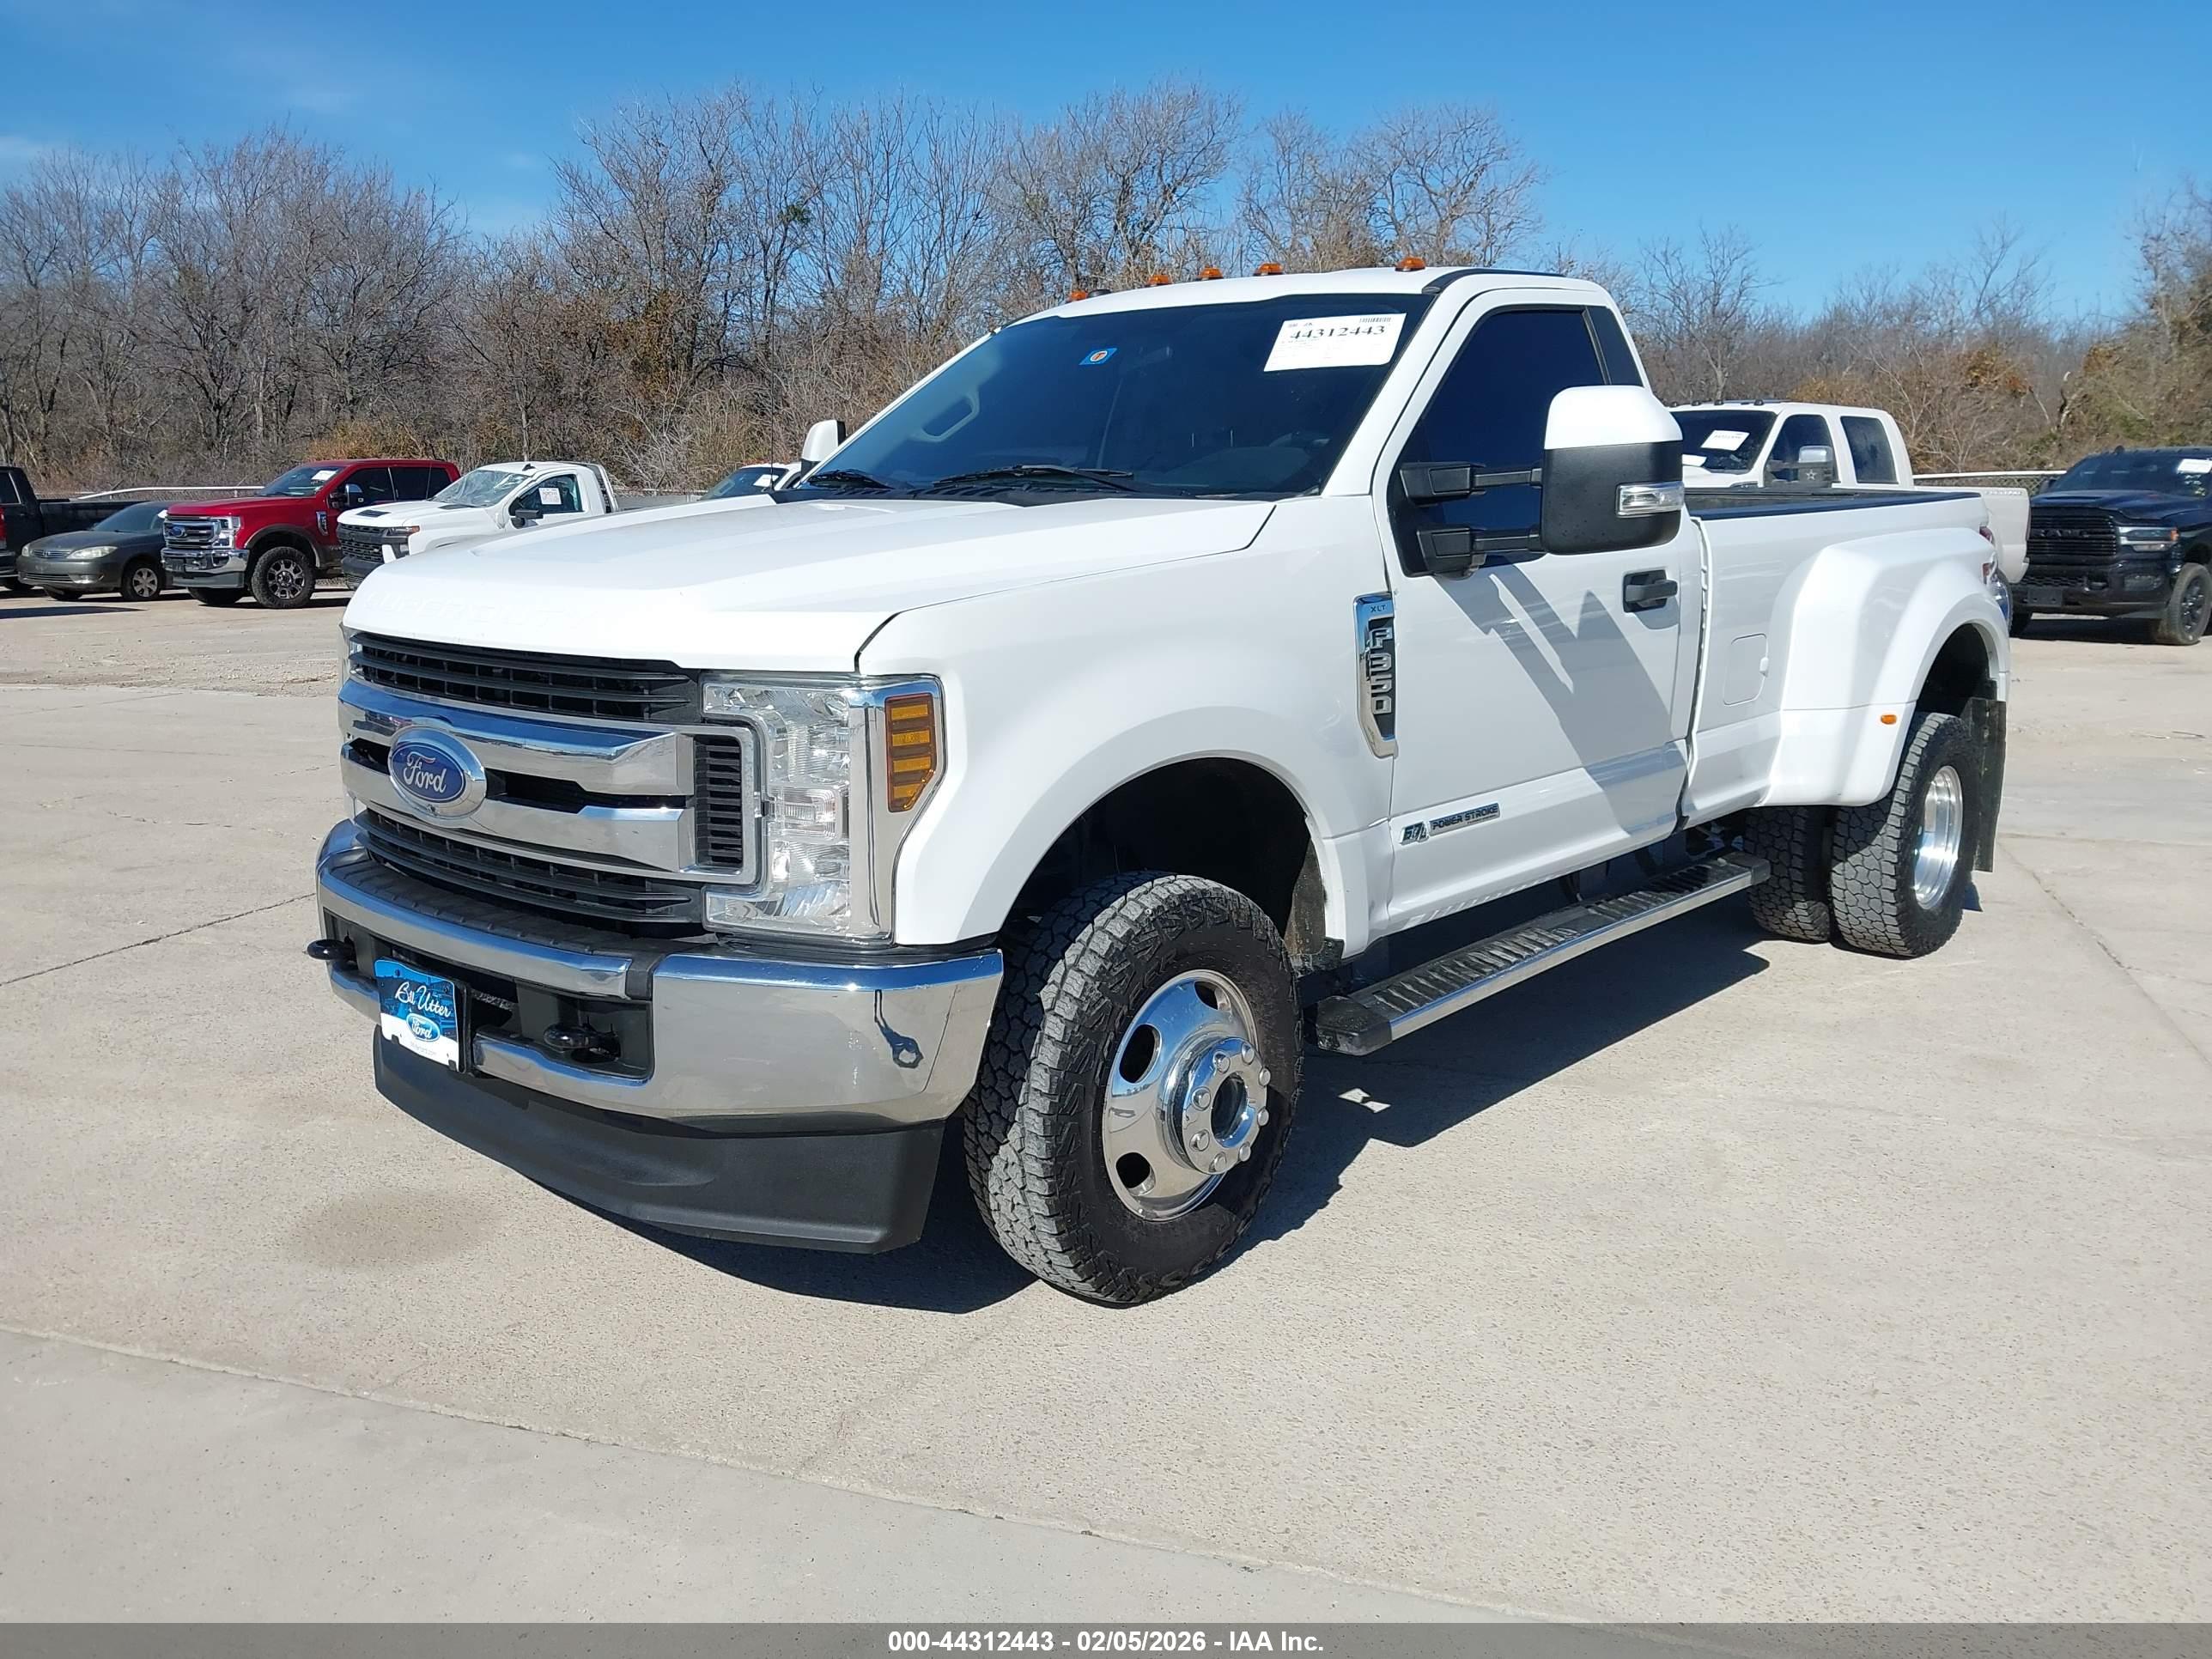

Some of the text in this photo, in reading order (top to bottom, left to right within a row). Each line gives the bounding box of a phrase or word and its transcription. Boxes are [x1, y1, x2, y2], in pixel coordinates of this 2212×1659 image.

[1290, 325, 1385, 339] 44312443
[1370, 605, 1386, 613] XLT
[404, 751, 447, 793] Ford
[1432, 815, 1463, 830] POWER
[1464, 805, 1498, 821] STROKE
[416, 986, 452, 1018] Utter
[411, 1018, 433, 1039] Ford
